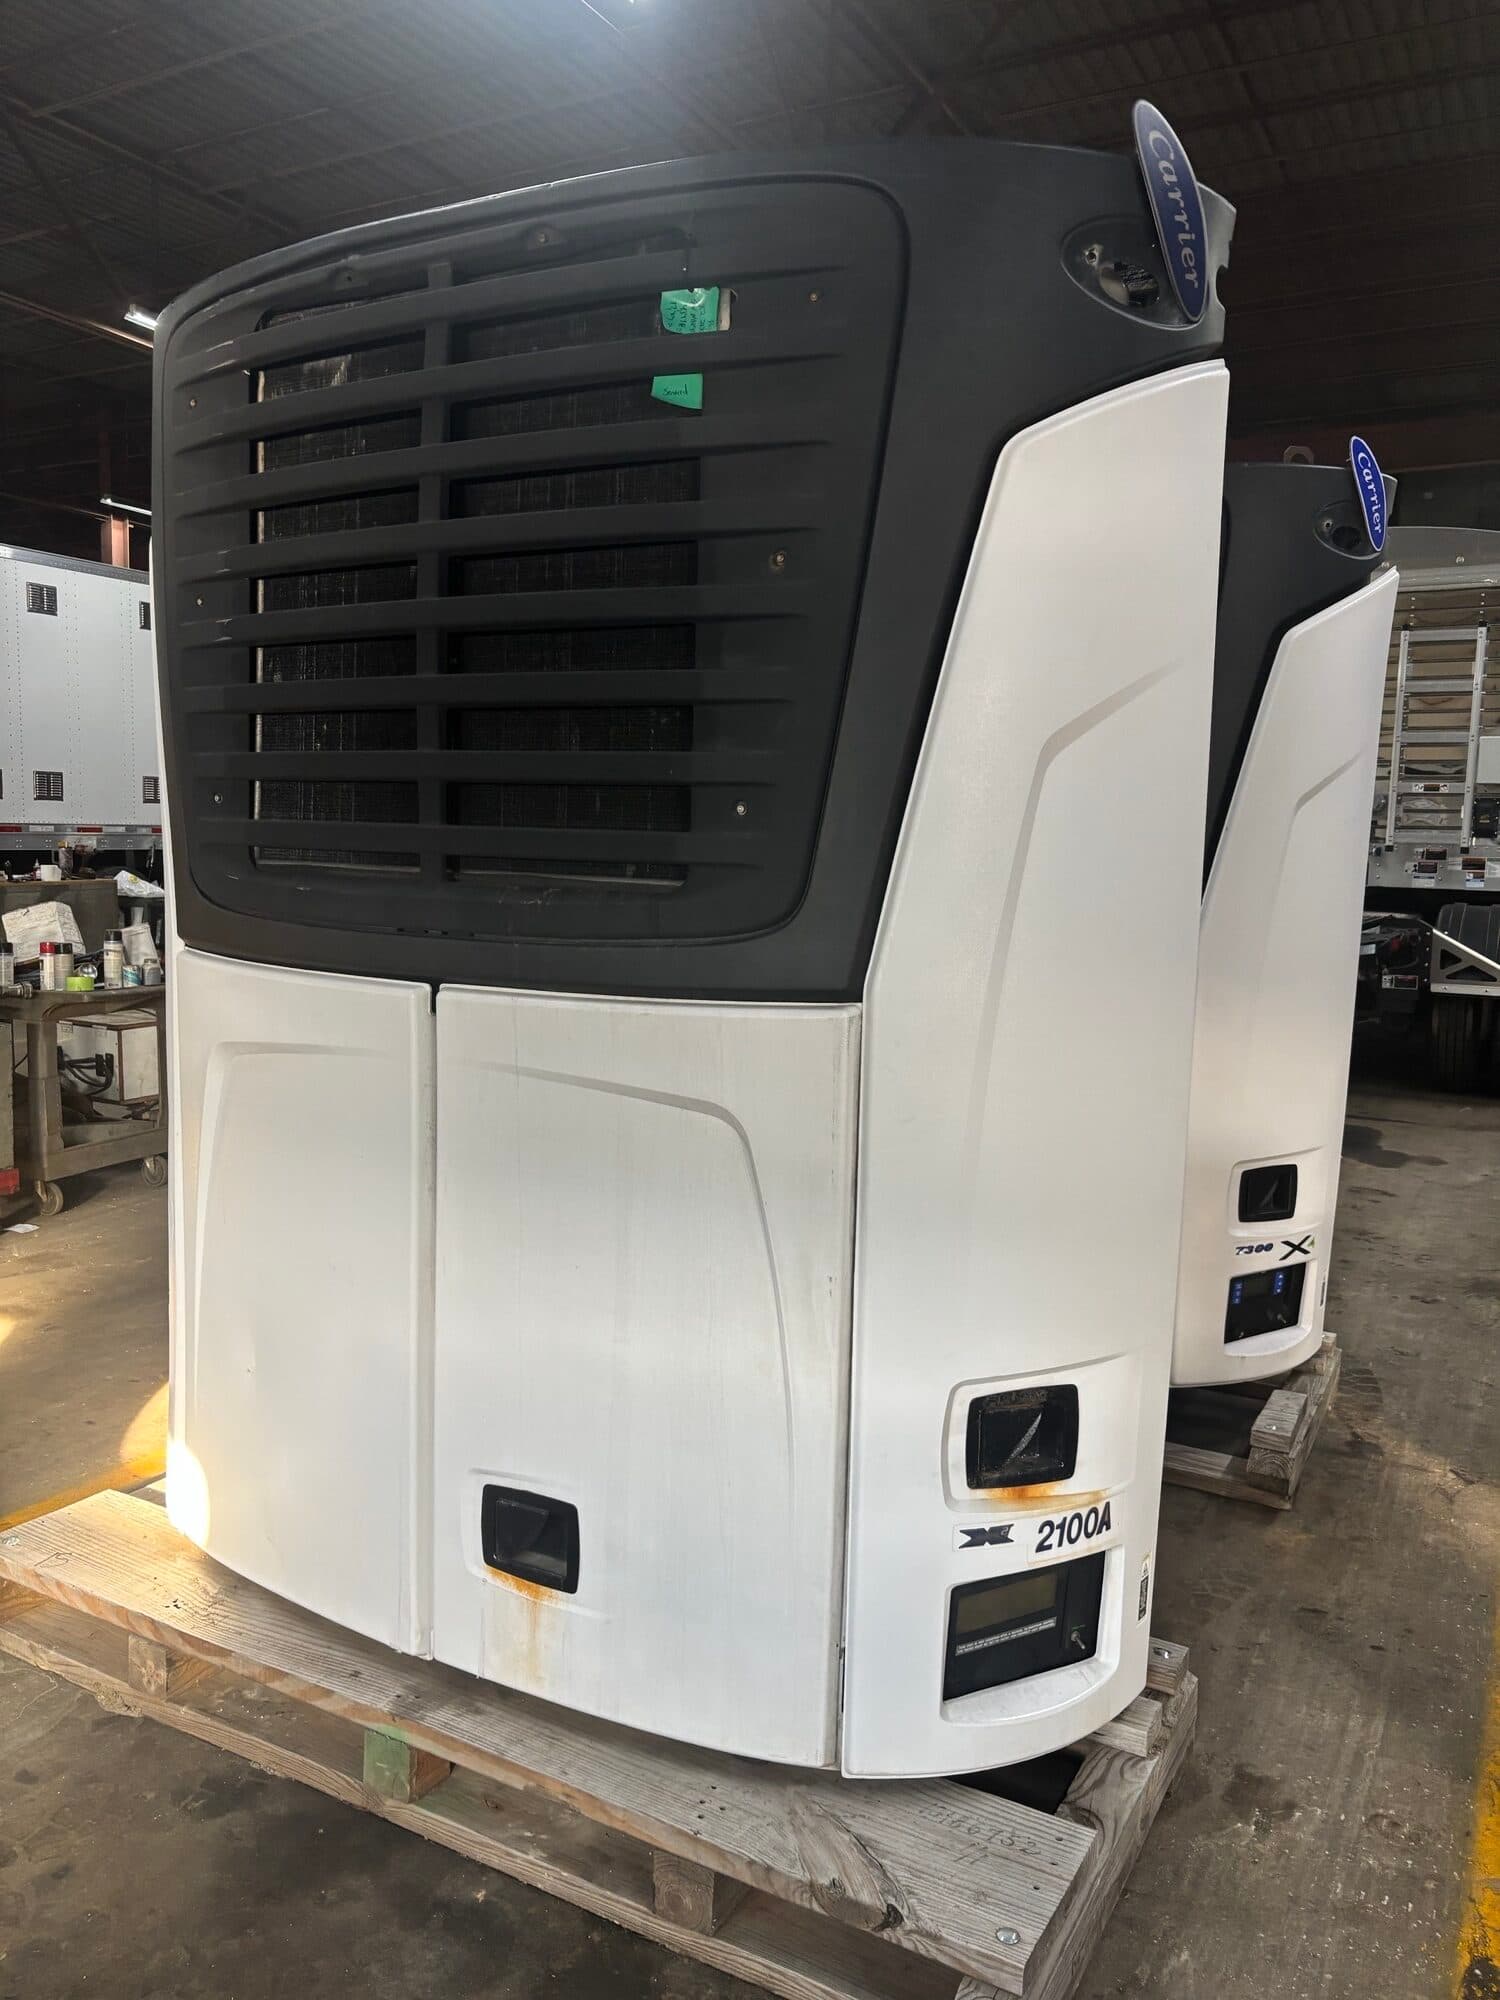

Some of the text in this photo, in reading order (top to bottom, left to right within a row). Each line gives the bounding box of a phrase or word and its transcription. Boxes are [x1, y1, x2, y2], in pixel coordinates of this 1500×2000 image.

[1149, 129, 1199, 289] Carrier
[1358, 452, 1382, 534] Carrier
[1035, 1501, 1111, 1553] 2100A
